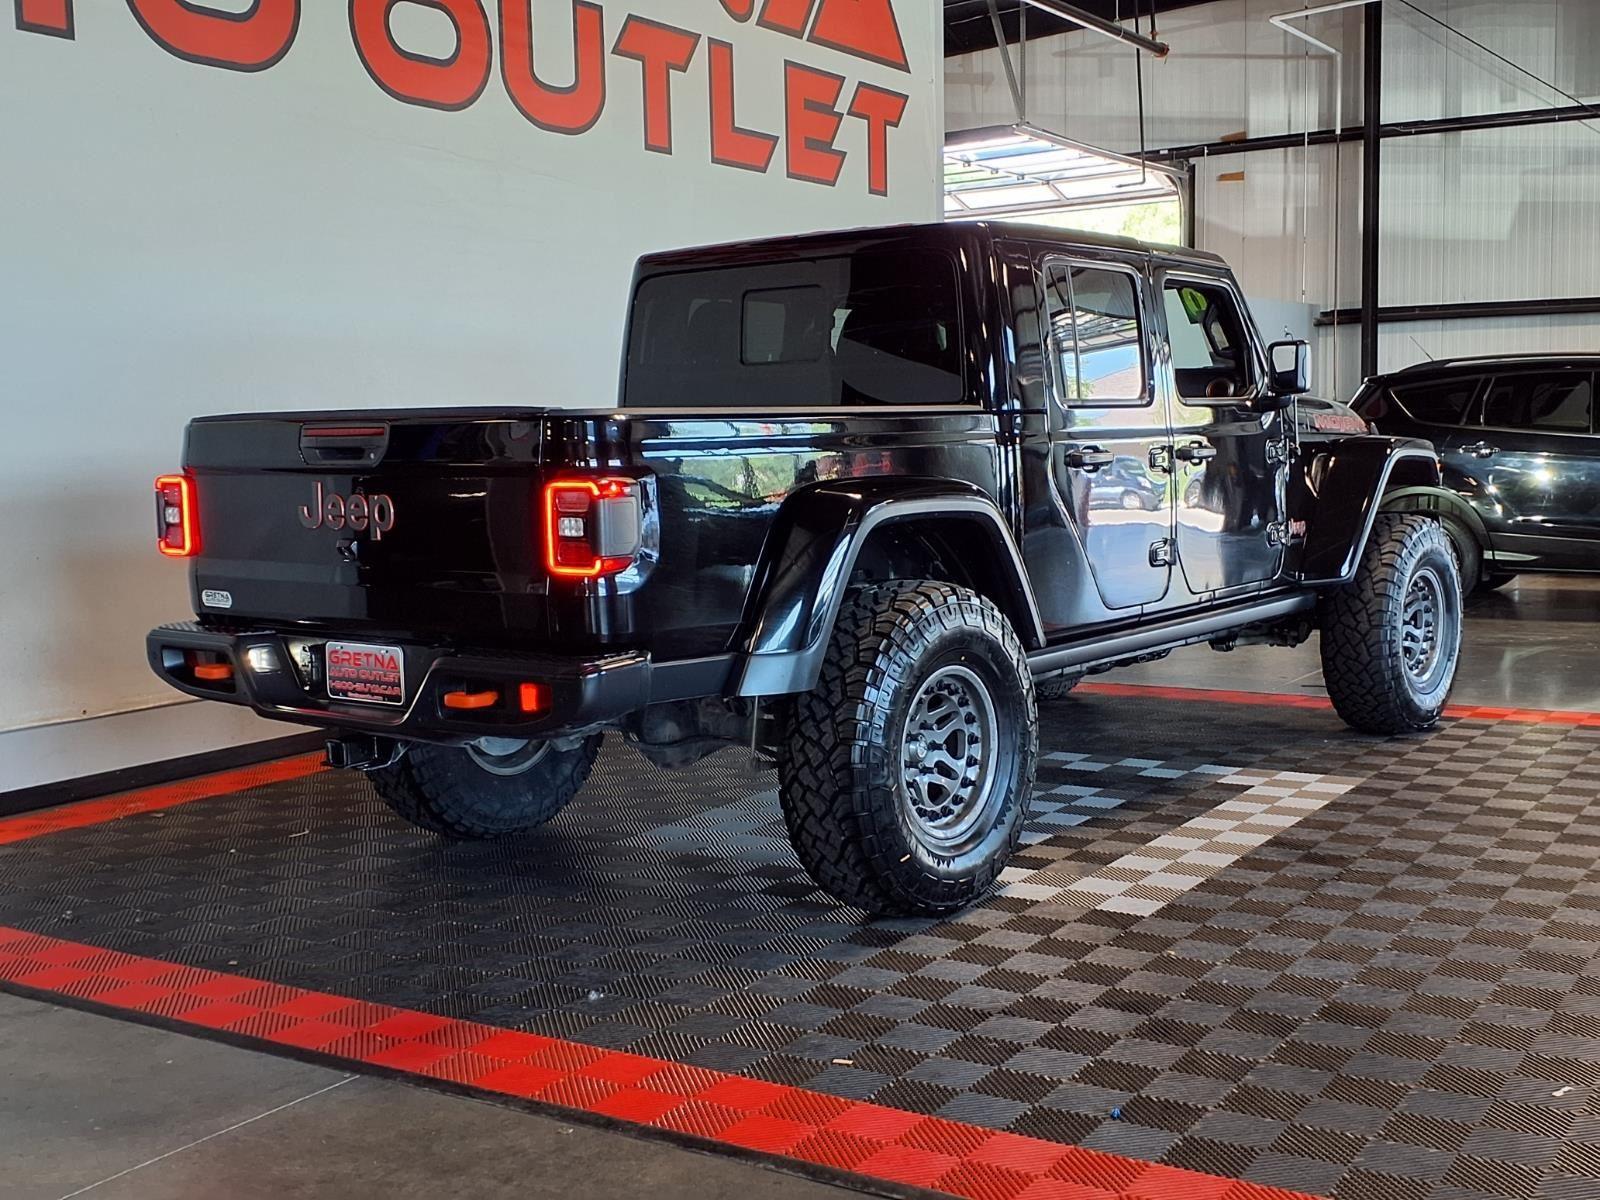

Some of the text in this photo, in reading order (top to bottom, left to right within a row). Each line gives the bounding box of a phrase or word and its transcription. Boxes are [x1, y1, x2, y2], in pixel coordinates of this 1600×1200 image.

[348, 0, 910, 197] OUTLET
[299, 481, 395, 541] Jeep
[329, 650, 398, 670] GRETNA
[329, 667, 400, 683] AUTO OUTLET
